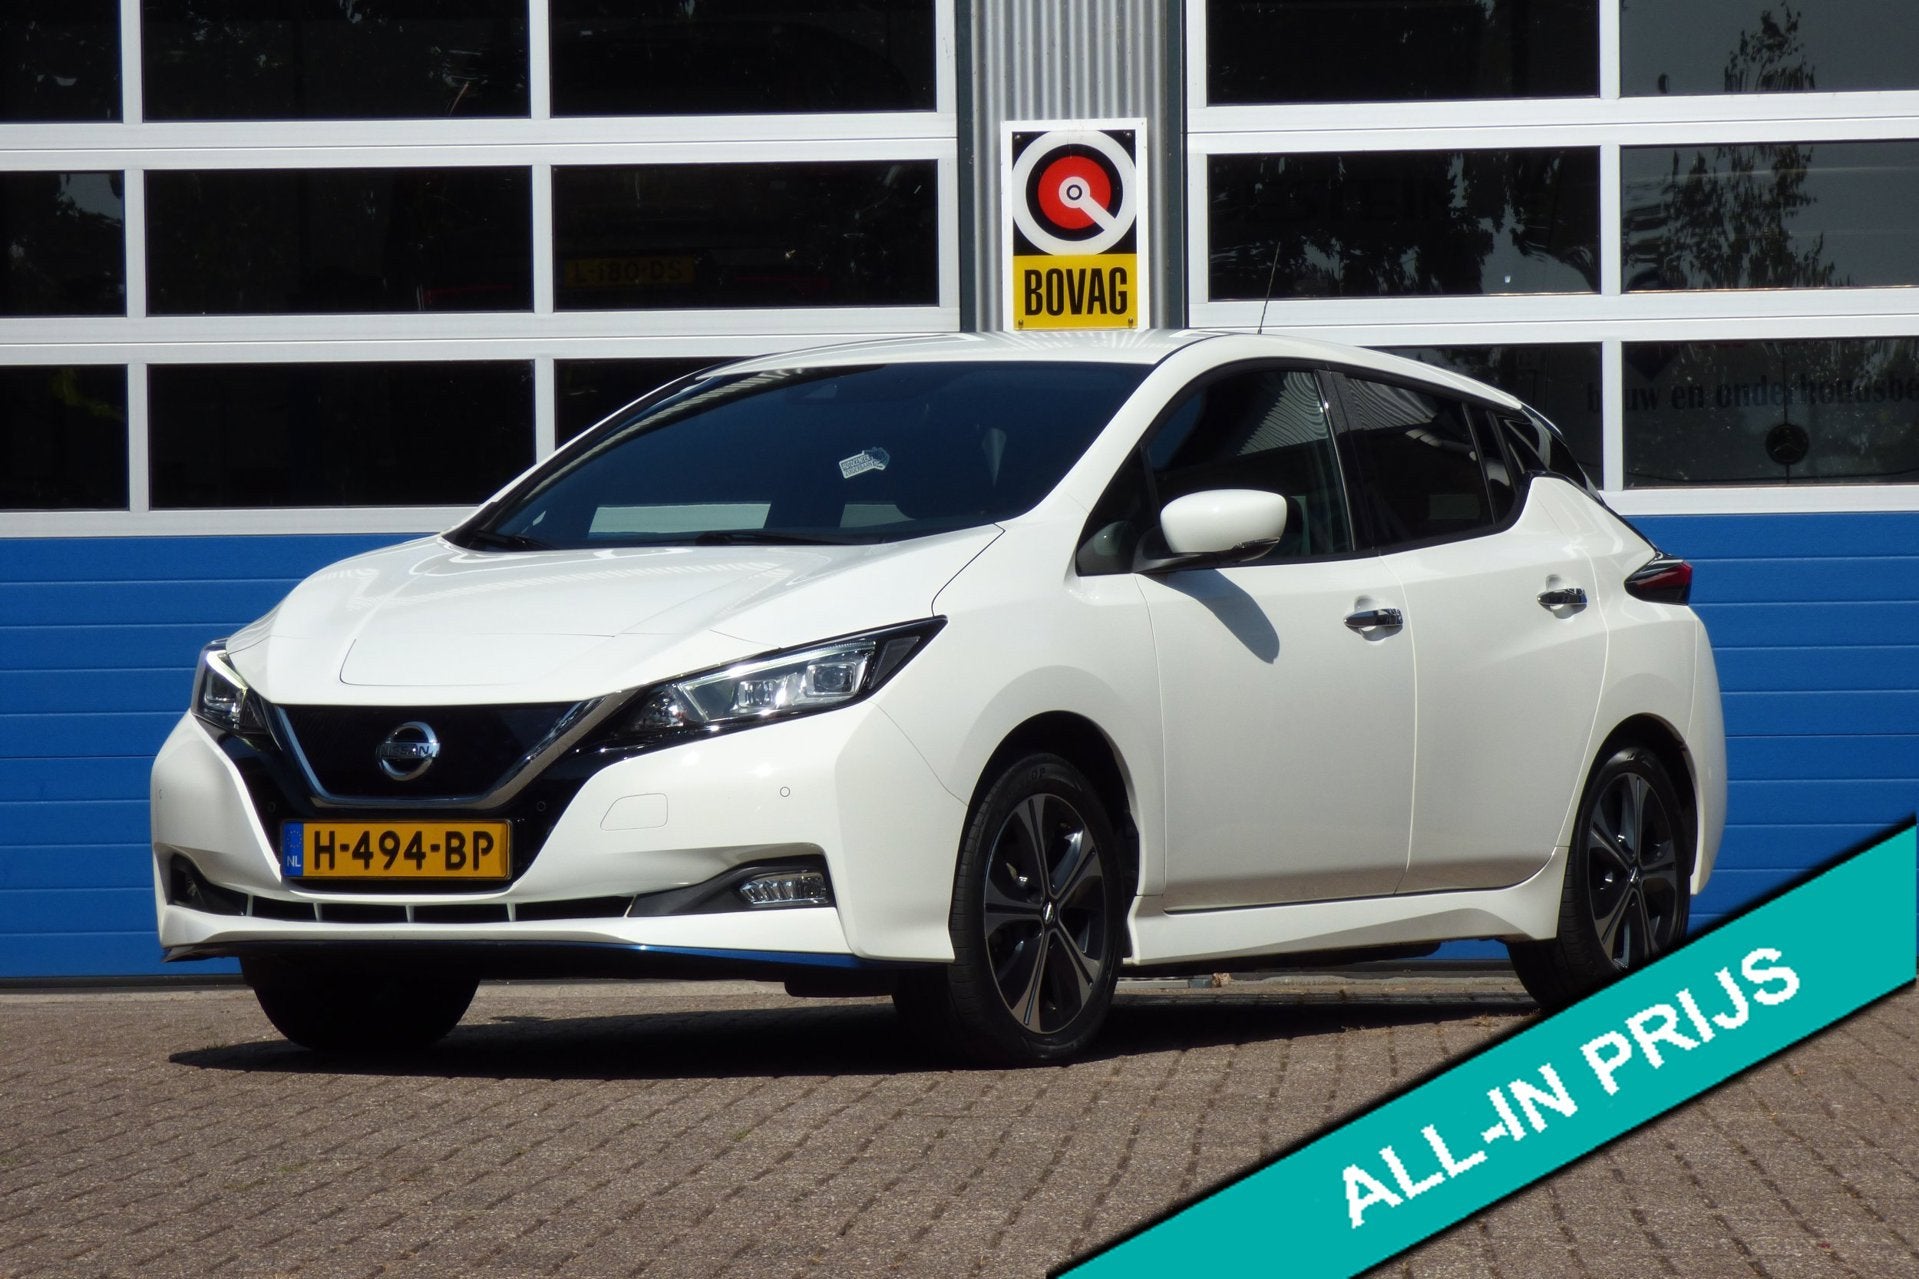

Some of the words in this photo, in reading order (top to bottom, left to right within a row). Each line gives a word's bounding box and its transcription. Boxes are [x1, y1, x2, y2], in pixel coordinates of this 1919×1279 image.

[1024, 267, 1128, 316] BOVAG
[1670, 382, 1705, 410] en
[286, 855, 302, 868] NL
[313, 830, 495, 871] H-494-BP
